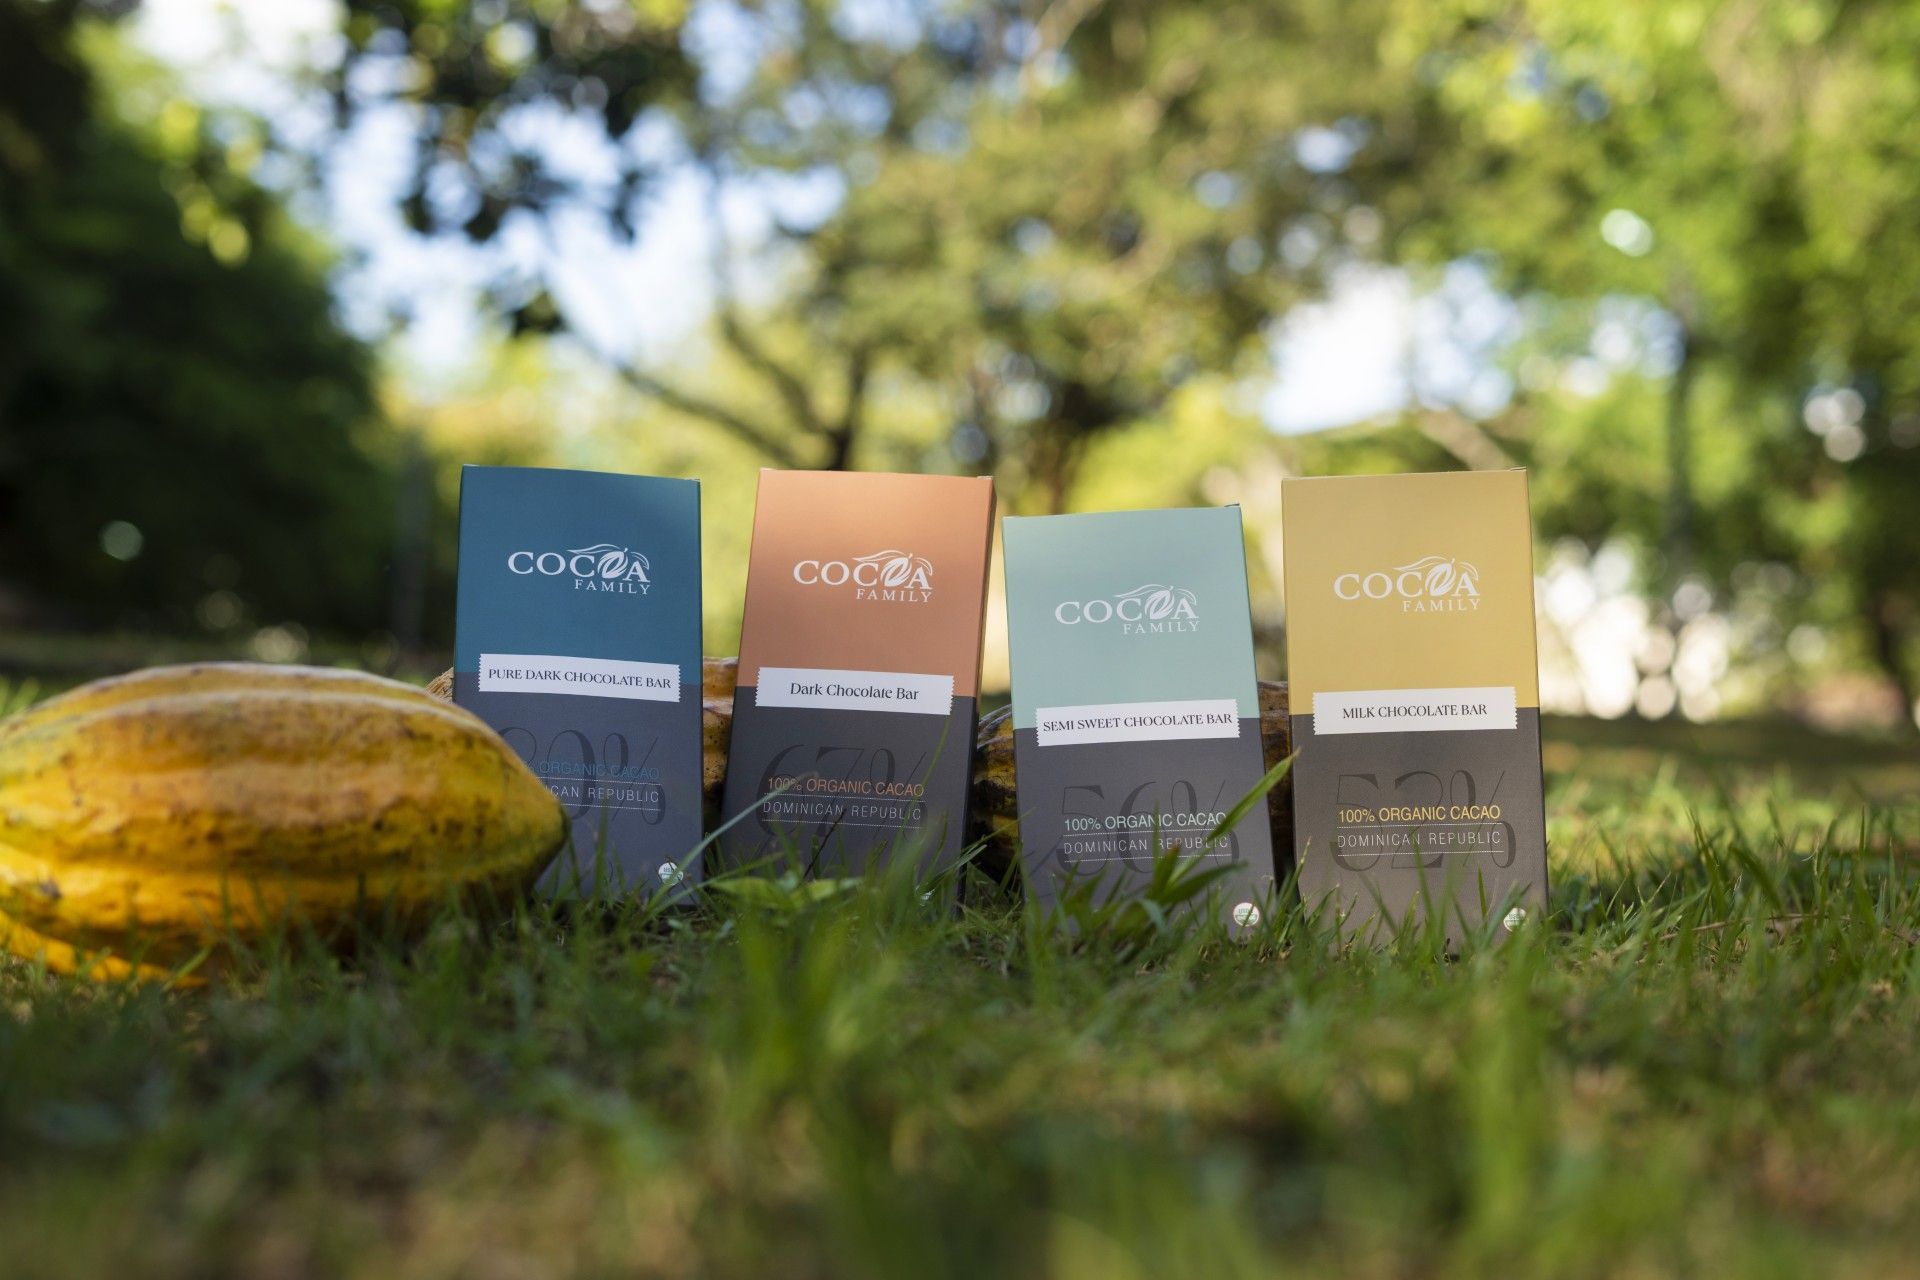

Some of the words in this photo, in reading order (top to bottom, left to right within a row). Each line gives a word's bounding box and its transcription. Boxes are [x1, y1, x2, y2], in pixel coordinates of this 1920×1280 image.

[508, 547, 651, 582] COCOA
[793, 553, 933, 589] COCOA
[575, 579, 650, 595] FAMILY
[1334, 559, 1480, 600] COCOA
[856, 588, 932, 603] FAMILY
[1403, 598, 1480, 612] FAMILY
[1055, 587, 1199, 624] COCOA
[1123, 621, 1200, 634] FAMILY
[489, 668, 523, 680] PURE
[525, 669, 561, 681] DARK
[564, 671, 643, 687] CHOCOLATE
[646, 677, 671, 689] BAR
[790, 682, 822, 696] Dark
[826, 683, 893, 699] Chocolate
[896, 687, 919, 701] Bar
[1342, 706, 1376, 719] MILK
[1378, 704, 1457, 718] CHOCOLATE
[1461, 703, 1487, 716] BAR
[1043, 720, 1074, 732] SEMI
[1077, 718, 1121, 730] SWEET
[1124, 714, 1203, 728] CHOCOLATE
[1206, 713, 1232, 725] BAR
[539, 760, 606, 777] ORGANIC
[610, 763, 660, 780] CACAO
[588, 787, 660, 803] REPUBLIC
[768, 777, 803, 791] 100%
[806, 778, 872, 794] ORGANIC
[875, 781, 924, 797] CACAO
[763, 801, 844, 816] DOMINICAN
[851, 805, 921, 820] REPUBLIC
[1338, 809, 1375, 823] 100%
[1379, 806, 1446, 822] ORGANIC
[1450, 805, 1501, 820] CACAO
[1056, 779, 1239, 877] 56%
[1065, 816, 1101, 831] 100%
[1105, 813, 1173, 830] ORGANIC
[1329, 770, 1516, 872] 52%
[1064, 838, 1148, 855] DOMINICAN
[1337, 832, 1420, 848] DOMINICAN
[1429, 831, 1501, 846] REPUBLIC
